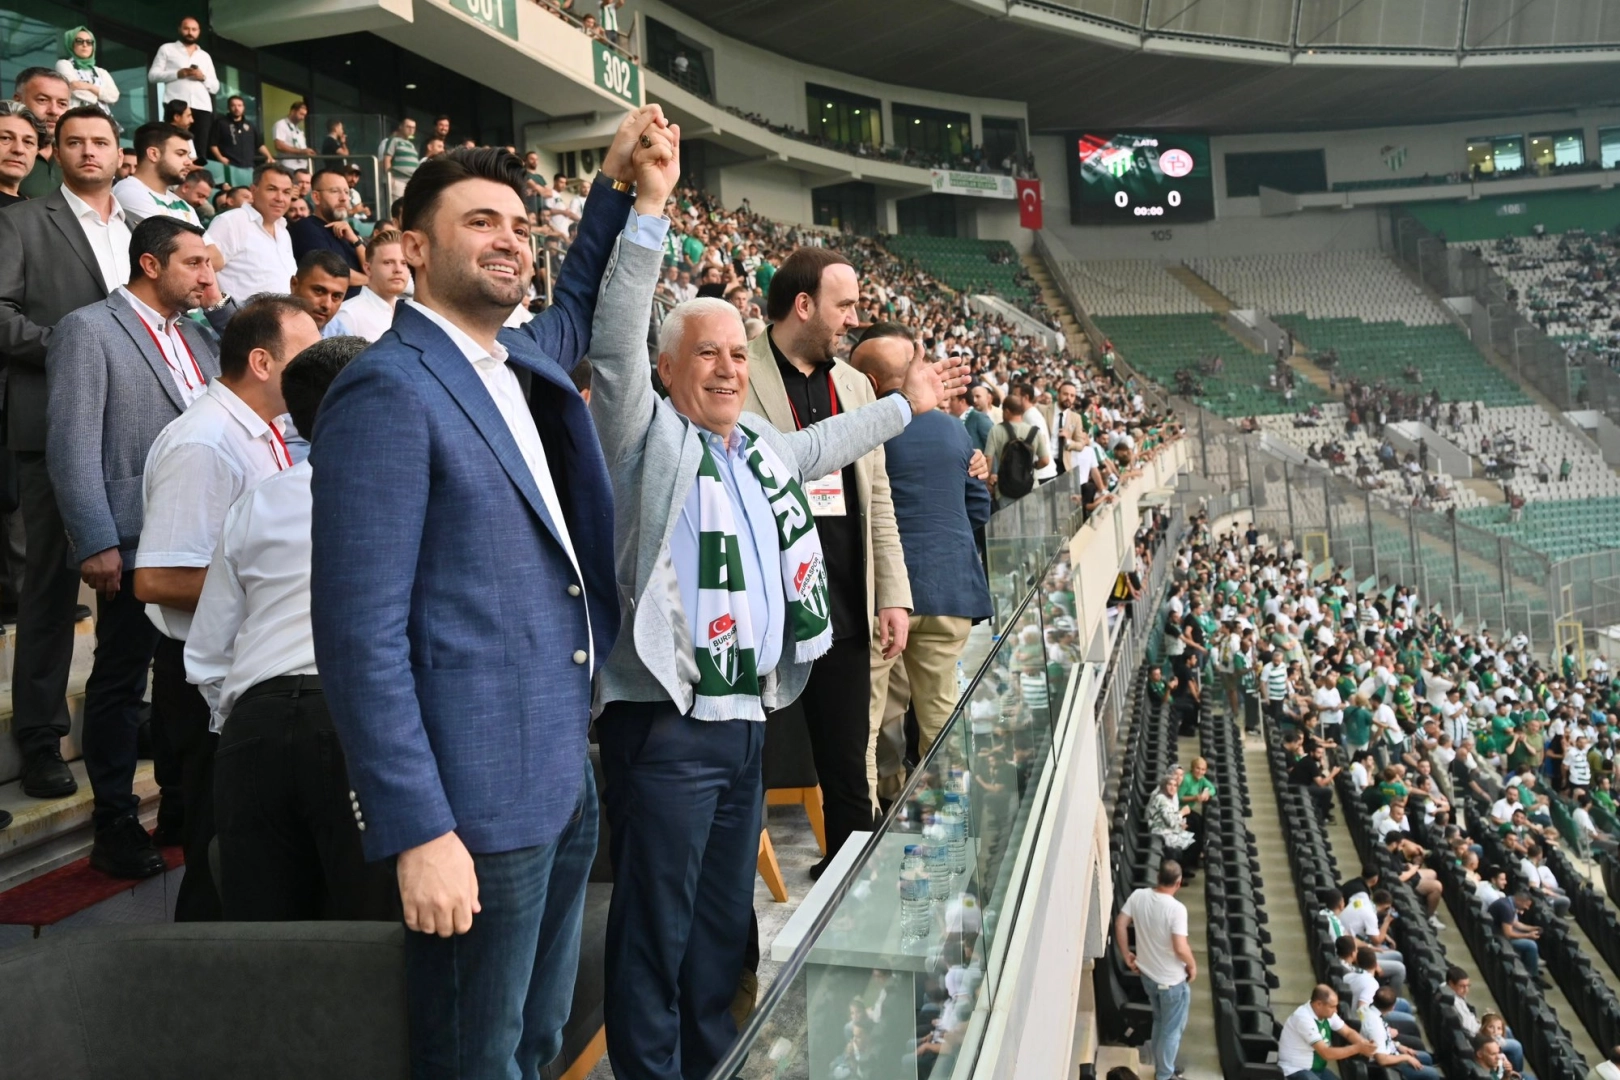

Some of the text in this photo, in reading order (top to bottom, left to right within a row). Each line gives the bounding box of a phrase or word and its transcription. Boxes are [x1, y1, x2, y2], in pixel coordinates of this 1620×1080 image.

[602, 49, 632, 99] 302
[1114, 190, 1182, 208] 0 0
[1133, 206, 1164, 216] 00:00
[1150, 229, 1173, 241] 105
[800, 557, 819, 596] BURSASPOR
